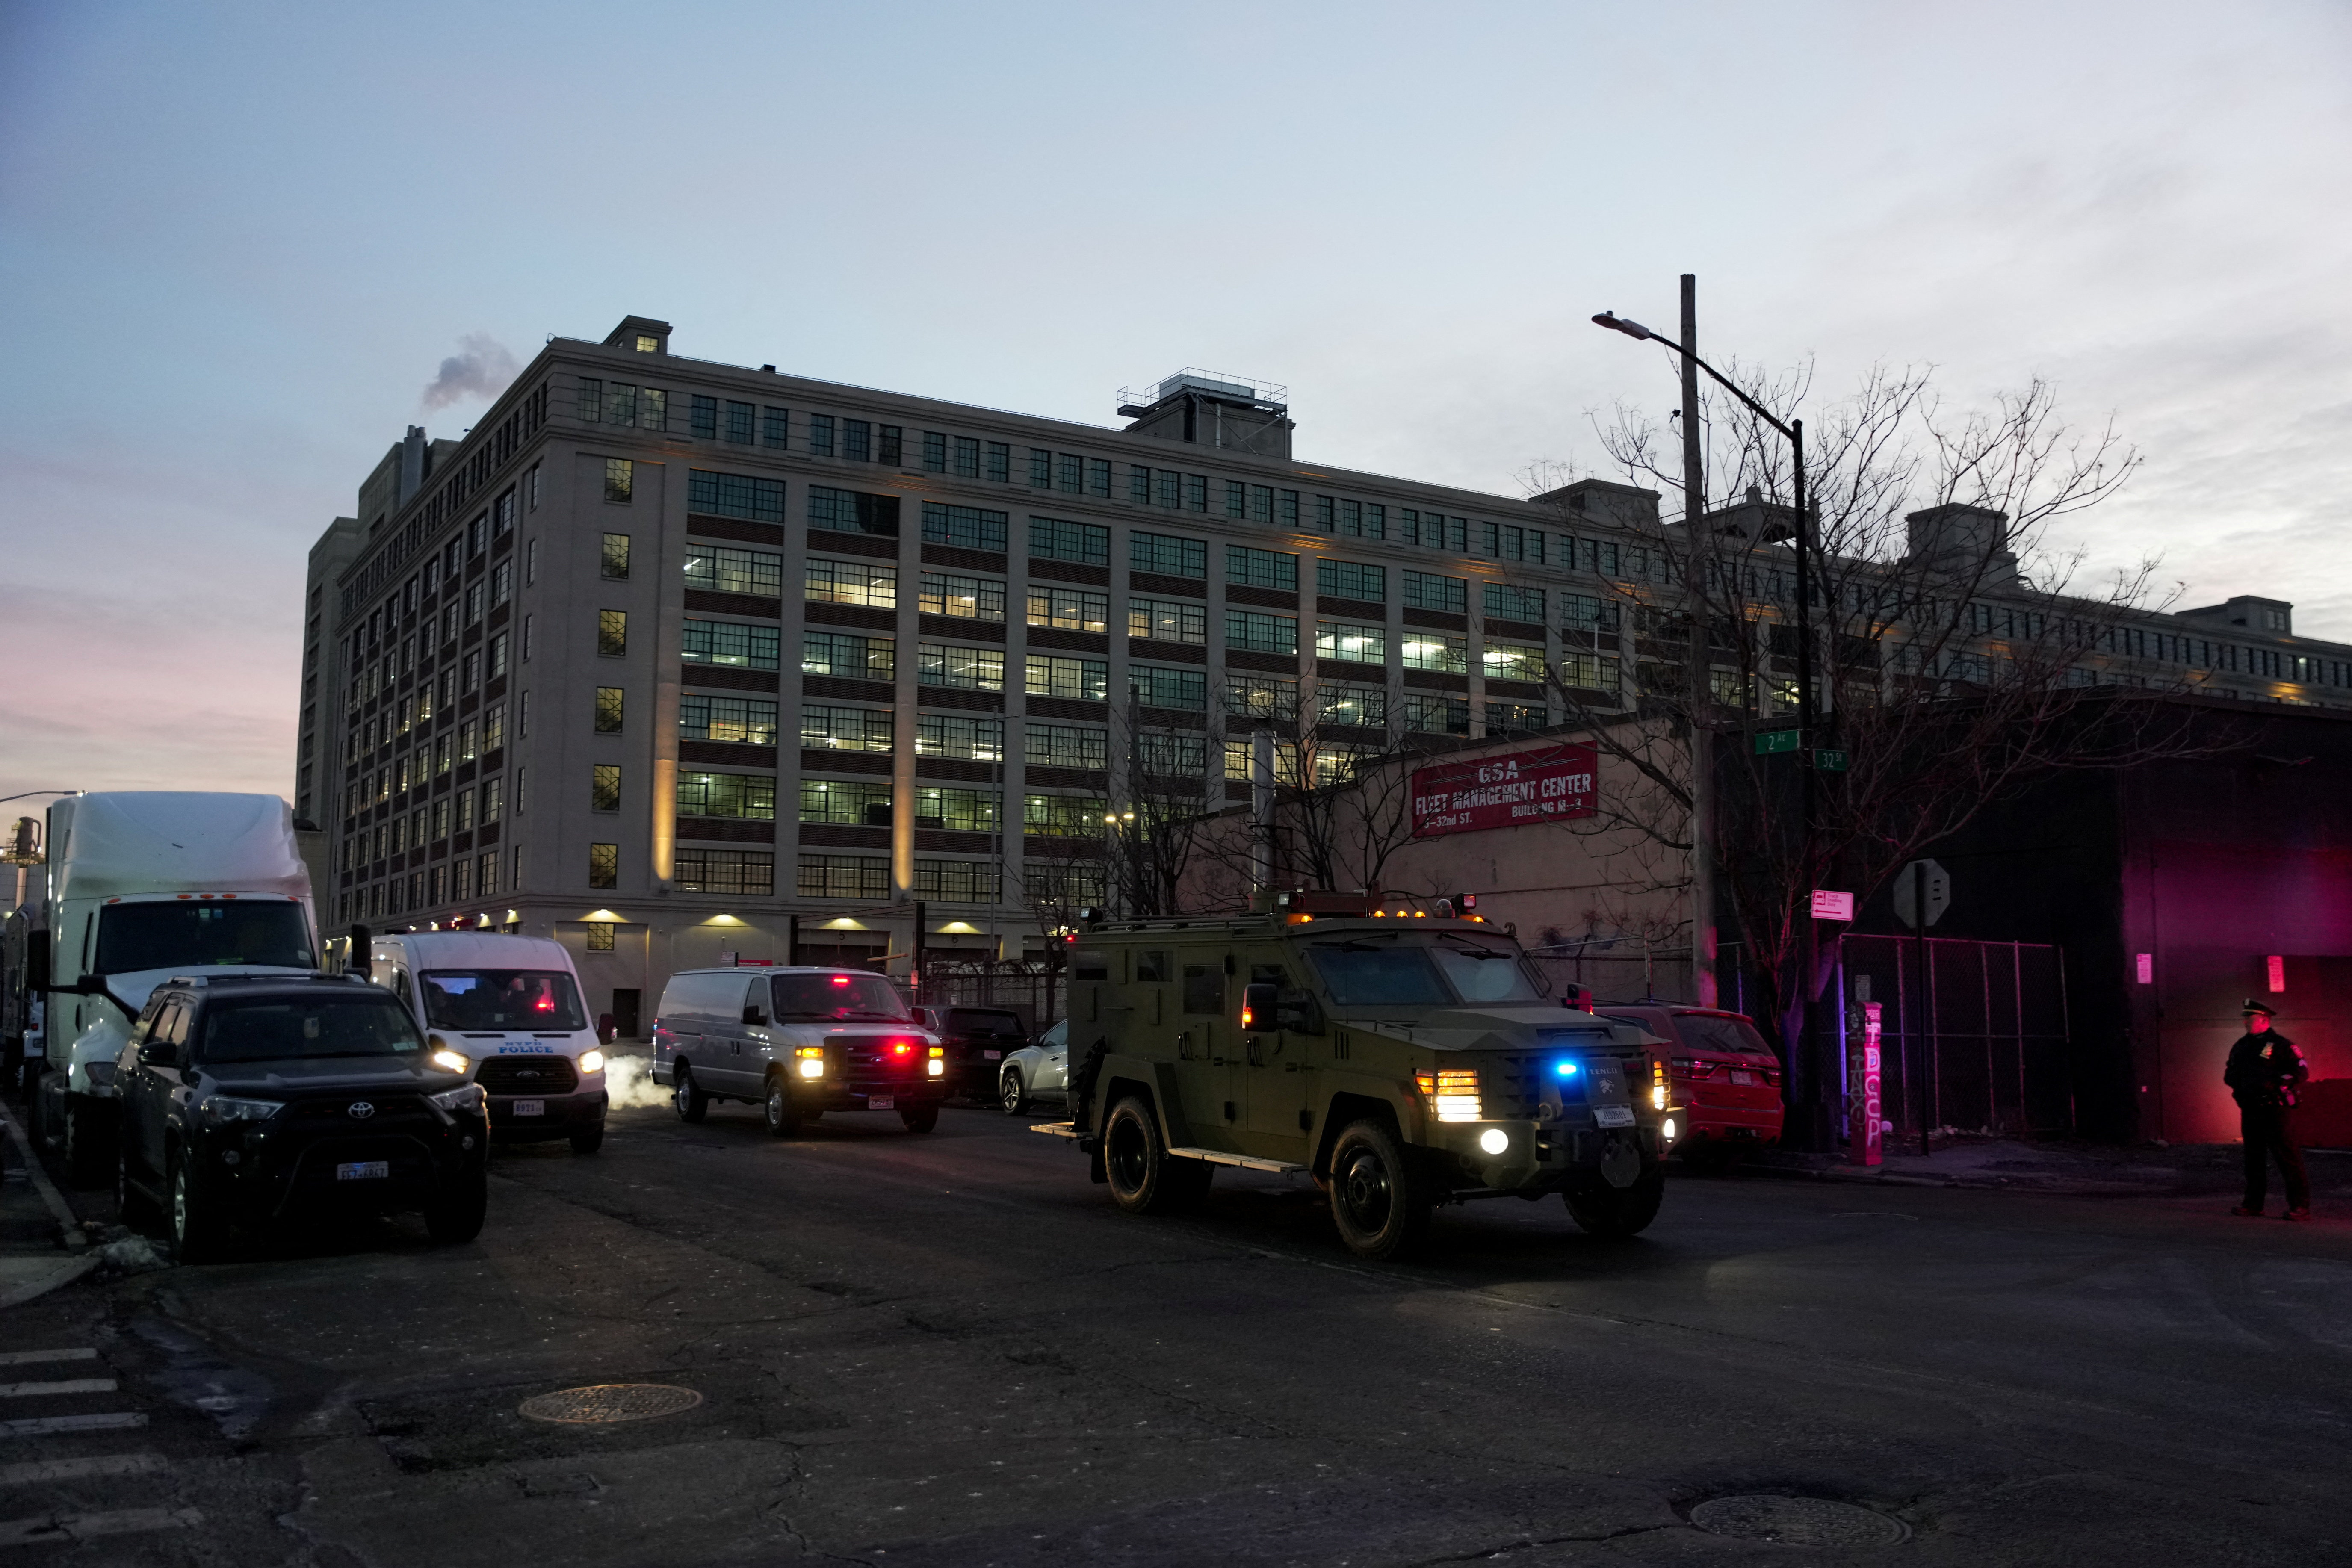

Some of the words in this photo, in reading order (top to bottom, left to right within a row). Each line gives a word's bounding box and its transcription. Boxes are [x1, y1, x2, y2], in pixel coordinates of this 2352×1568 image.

[1768, 735, 1774, 750] 2
[1823, 753, 1834, 768] 32
[1478, 760, 1519, 783] GSA
[1416, 793, 1448, 815] FLEET
[1453, 780, 1536, 810] MANAGEMENT
[1541, 773, 1591, 798] CENTER
[1460, 812, 1473, 824] ST.
[839, 930, 845, 940] 5
